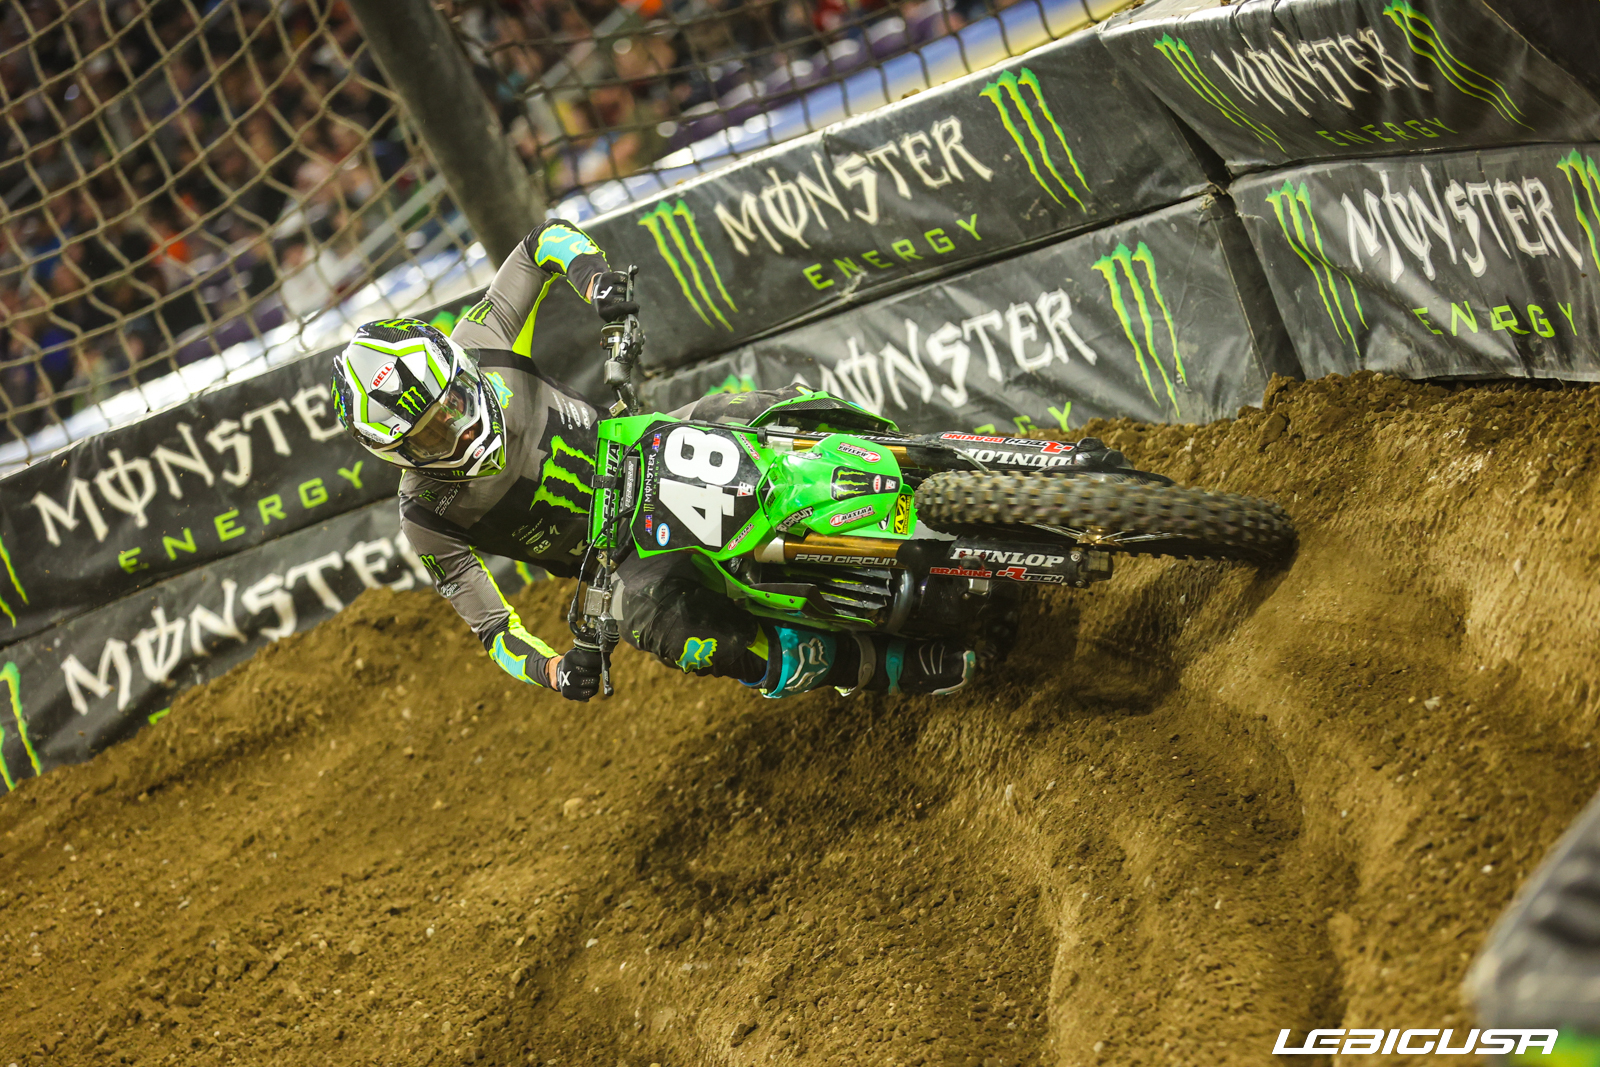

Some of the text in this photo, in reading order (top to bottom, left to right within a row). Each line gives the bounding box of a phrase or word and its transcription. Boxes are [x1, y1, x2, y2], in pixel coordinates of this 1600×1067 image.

[1211, 26, 1432, 118] MONSTER
[1315, 117, 1458, 147] ENERGY
[714, 114, 994, 256] MONSTER
[1341, 164, 1583, 284] MONSTER
[802, 213, 983, 291] ENERGY
[1412, 301, 1578, 338] ENRGY
[373, 366, 392, 387] BELL
[652, 433, 661, 452] AMA
[940, 433, 1006, 443] BRAKING
[31, 384, 346, 546] MONSTE
[644, 453, 656, 503] MONSTER
[659, 426, 740, 547] 48
[118, 460, 365, 573] ENERGY
[794, 553, 833, 563] PRO
[930, 567, 993, 578] BRAKING
